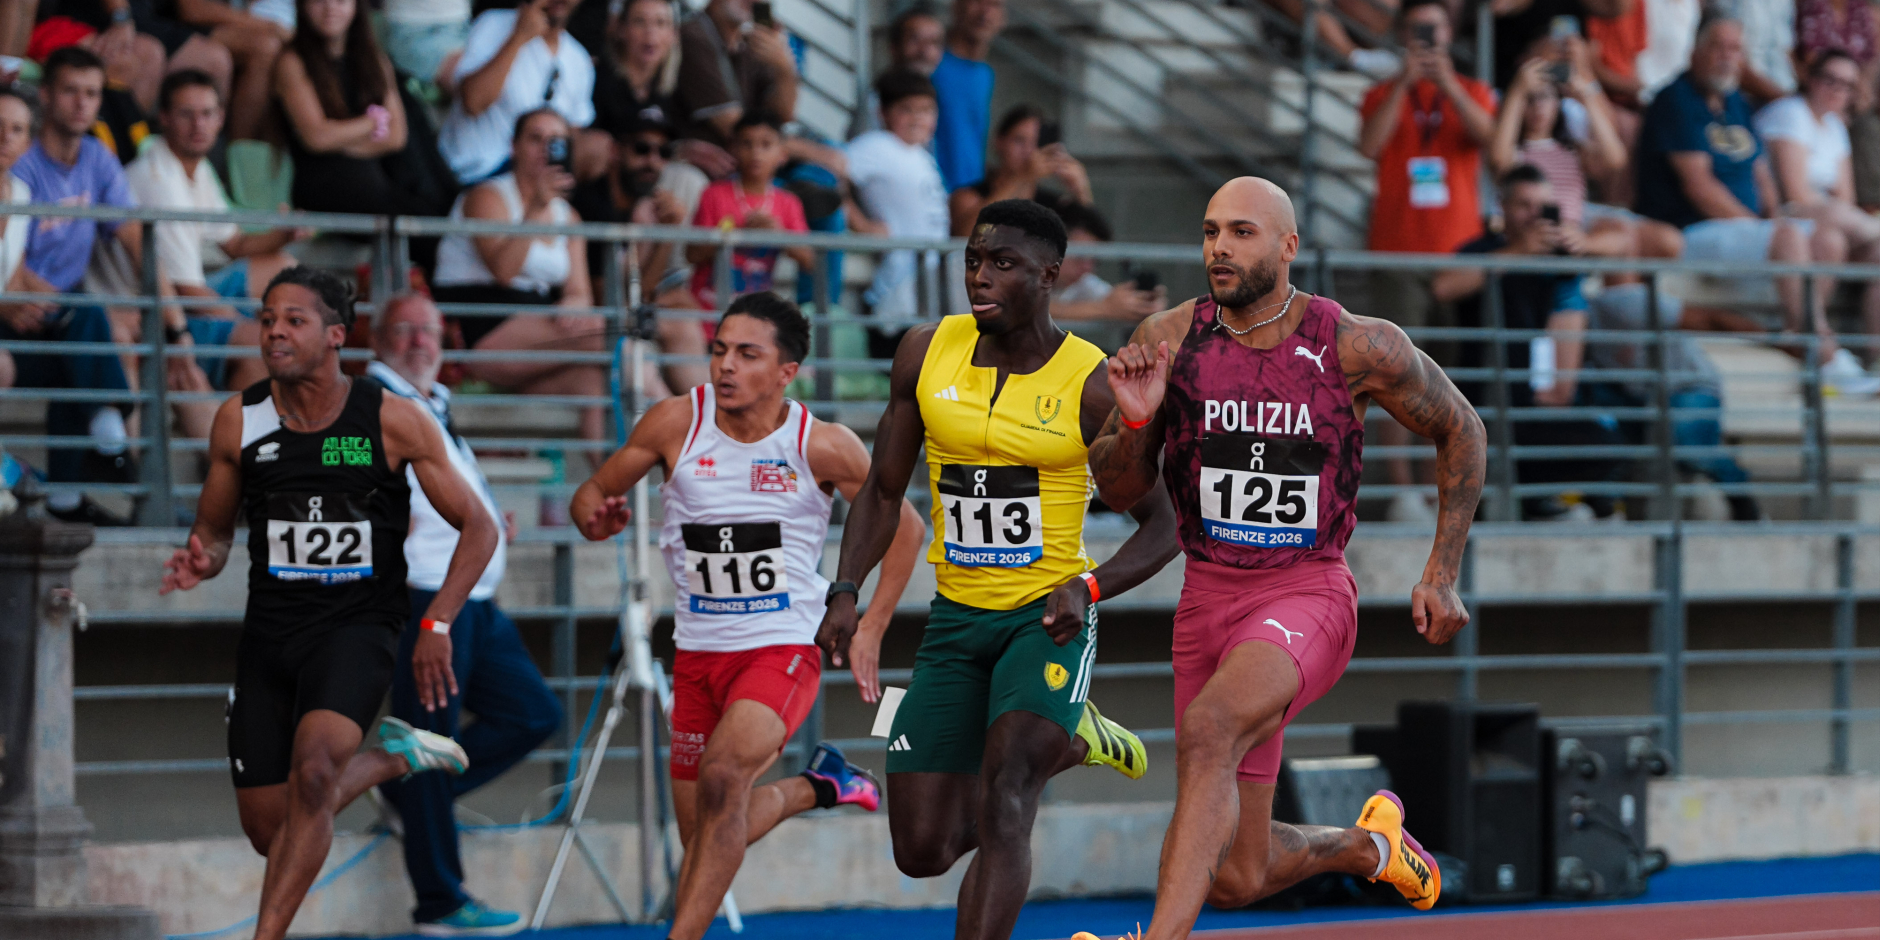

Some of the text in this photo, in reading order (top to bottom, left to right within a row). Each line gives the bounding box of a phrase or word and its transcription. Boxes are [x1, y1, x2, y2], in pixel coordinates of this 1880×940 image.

[1204, 399, 1314, 435] POLIZIA
[321, 436, 372, 450] ATLETICA
[1213, 473, 1307, 525] 125
[949, 500, 1032, 545] 113
[1211, 525, 1303, 545] FIRENZE 2026
[280, 525, 361, 565] 122
[949, 549, 1031, 564] FIRENZE 2026
[696, 554, 776, 594] 116
[698, 597, 780, 611] FIRENZE 2026
